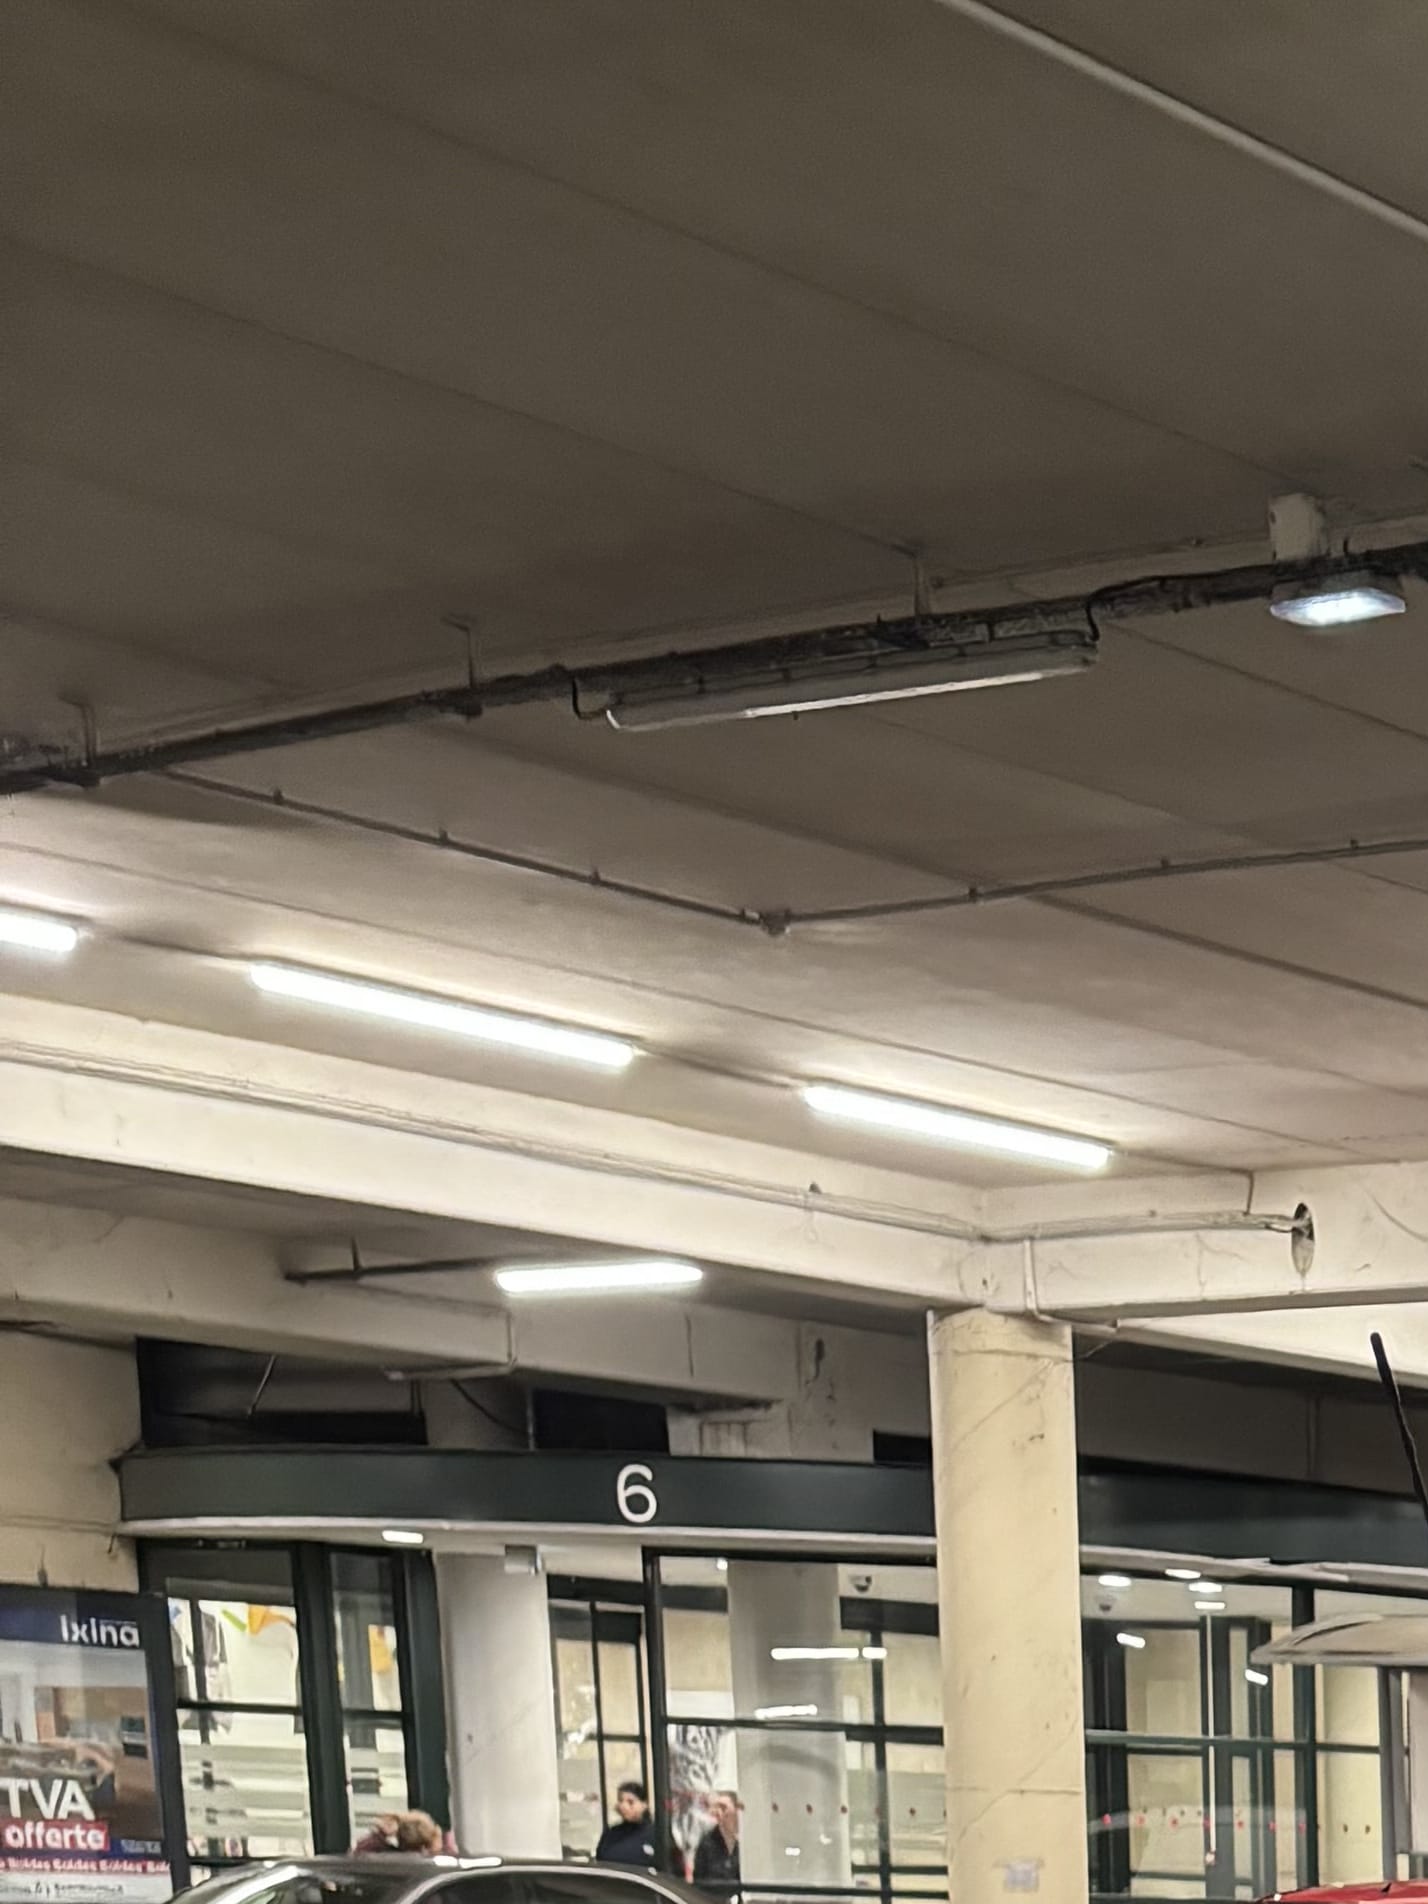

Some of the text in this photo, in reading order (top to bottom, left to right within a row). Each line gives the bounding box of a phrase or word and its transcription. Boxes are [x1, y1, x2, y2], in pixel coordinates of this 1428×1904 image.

[617, 1464, 657, 1523] 6
[0, 1779, 95, 1821] TVA
[5, 1820, 106, 1849] offerte
